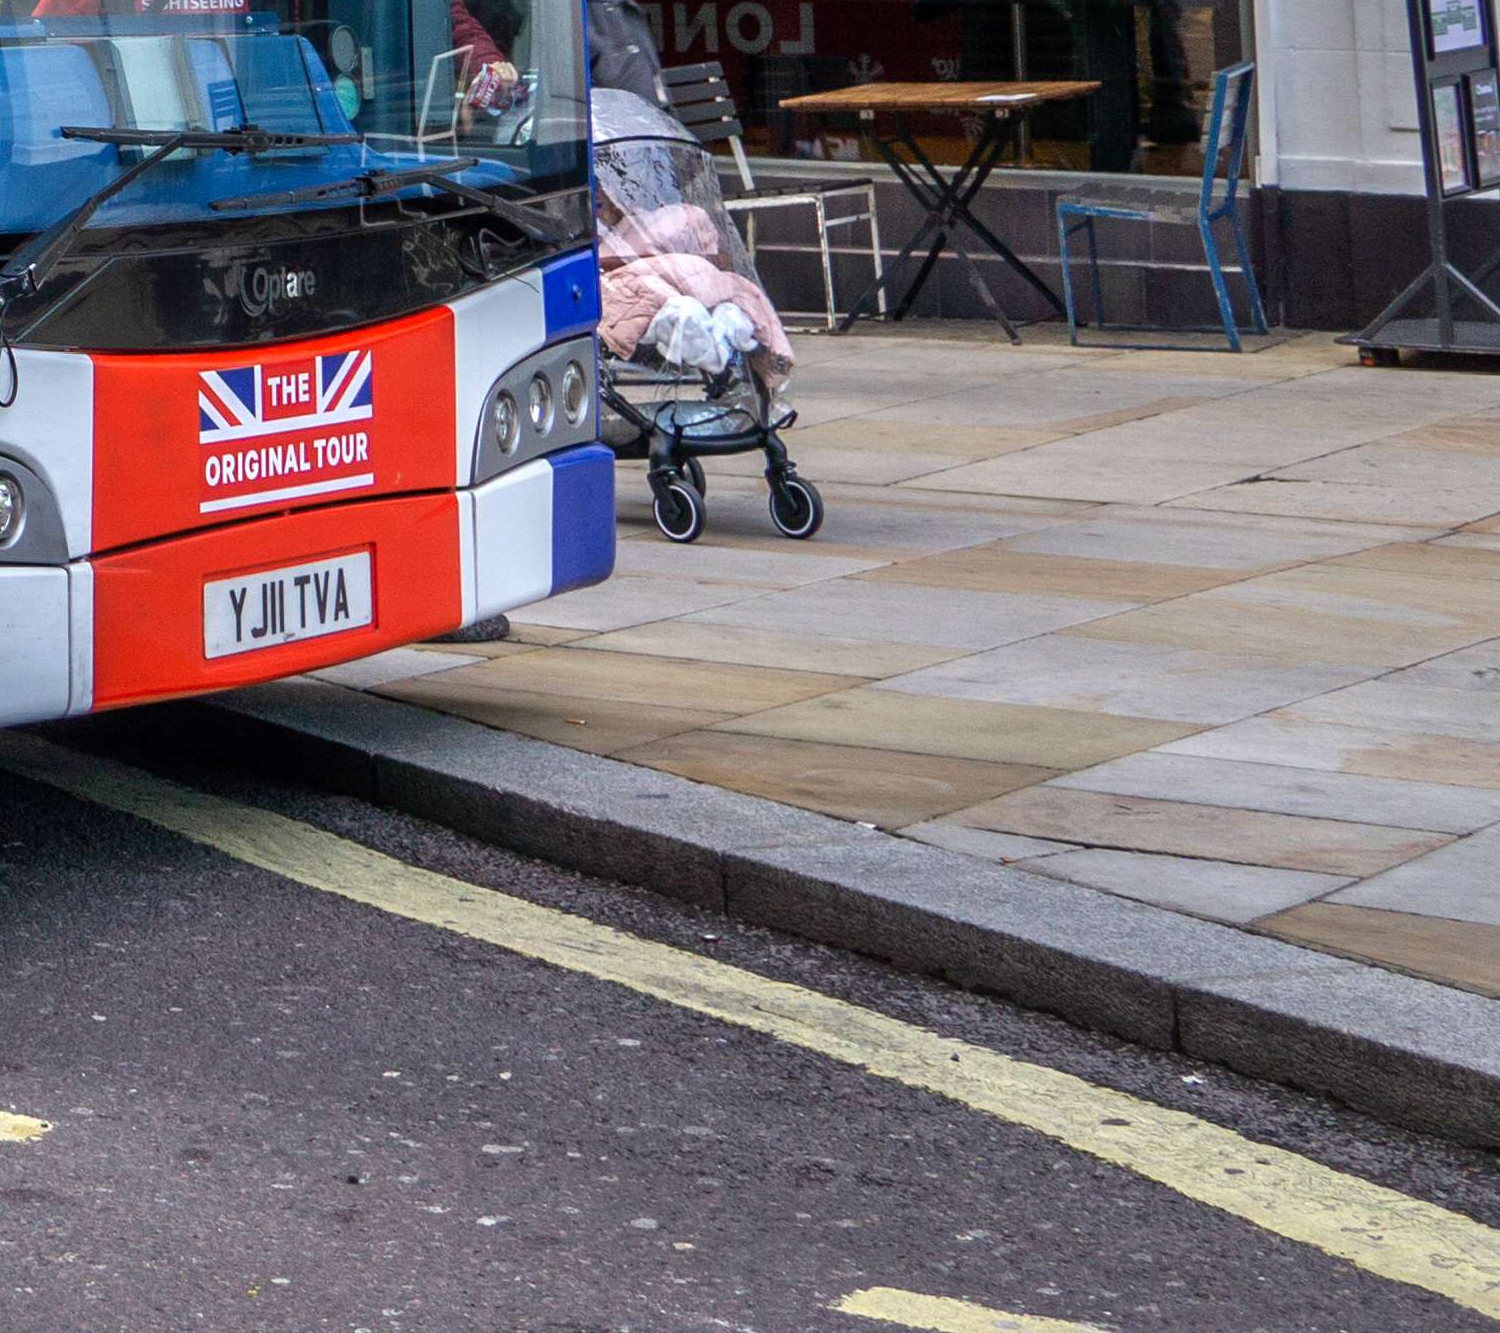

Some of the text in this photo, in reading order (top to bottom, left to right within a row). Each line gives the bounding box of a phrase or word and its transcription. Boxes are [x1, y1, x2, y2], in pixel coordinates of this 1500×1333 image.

[252, 266, 316, 310] Optare
[267, 372, 311, 407] THE
[204, 432, 369, 487] ORIGINAL TOUR
[229, 567, 350, 643] YJ11 TVA
